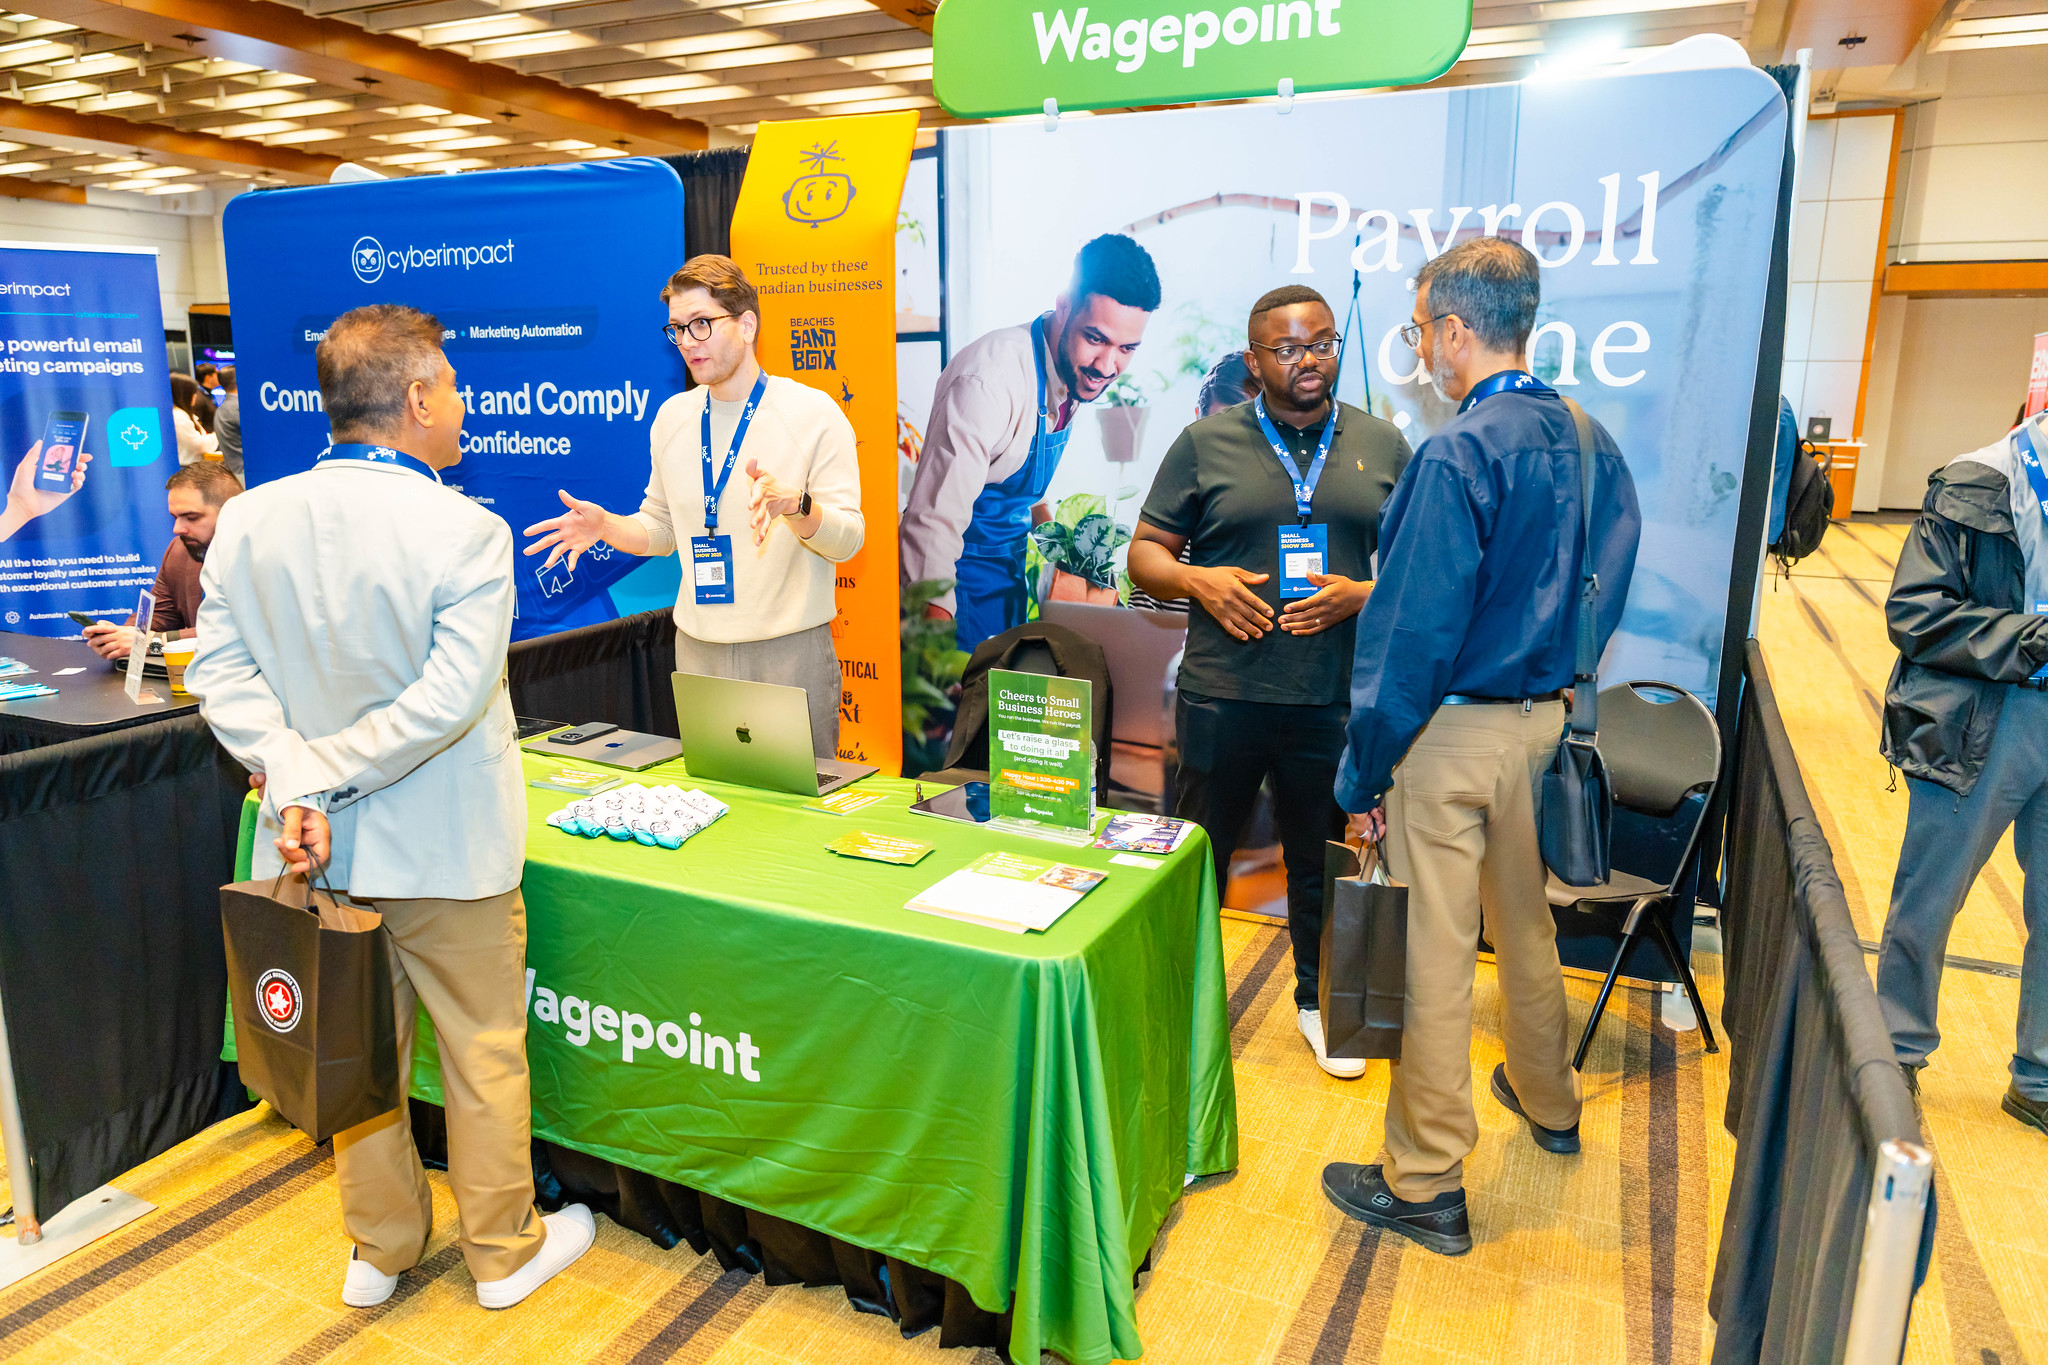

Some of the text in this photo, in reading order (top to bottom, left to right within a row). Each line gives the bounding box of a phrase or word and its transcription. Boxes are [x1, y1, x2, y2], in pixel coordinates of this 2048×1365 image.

[1032, 0, 1340, 73] Wagepoint
[387, 238, 514, 273] cyberimpact
[756, 260, 868, 276] Trusted by these
[753, 279, 883, 295] anadian businesses
[75, 311, 138, 319] cyberimpact.com
[790, 317, 834, 327] BEACHES
[305, 329, 328, 341] Emai
[470, 326, 520, 340] Marketing
[522, 324, 582, 338] Automation
[790, 328, 836, 349] SAND
[8, 338, 90, 354] powerful
[93, 339, 142, 353] email
[43, 359, 144, 376] campaigns
[791, 349, 837, 371] BOX
[260, 380, 323, 413] Conn
[480, 382, 531, 415] and
[536, 380, 650, 421] Comply
[458, 430, 571, 455] Confidence
[376, 447, 397, 459] bdc
[2021, 450, 2034, 466] bdc
[0, 553, 140, 568] All the tools you need to build
[34, 569, 67, 579] loyalty
[68, 568, 87, 577] and
[89, 566, 130, 575] increase
[131, 565, 156, 574] sales
[12, 581, 70, 593] exceptional
[71, 579, 117, 589] customer
[118, 577, 155, 587] service.
[99, 608, 133, 616] marketing
[999, 689, 1079, 708] Cheers to Small
[998, 700, 1081, 720] Business Heroes
[1002, 732, 1020, 740] Let's
[1023, 735, 1042, 743] raise
[1052, 738, 1073, 748] glass
[1021, 745, 1044, 755] doing
[1027, 757, 1043, 765] doing
